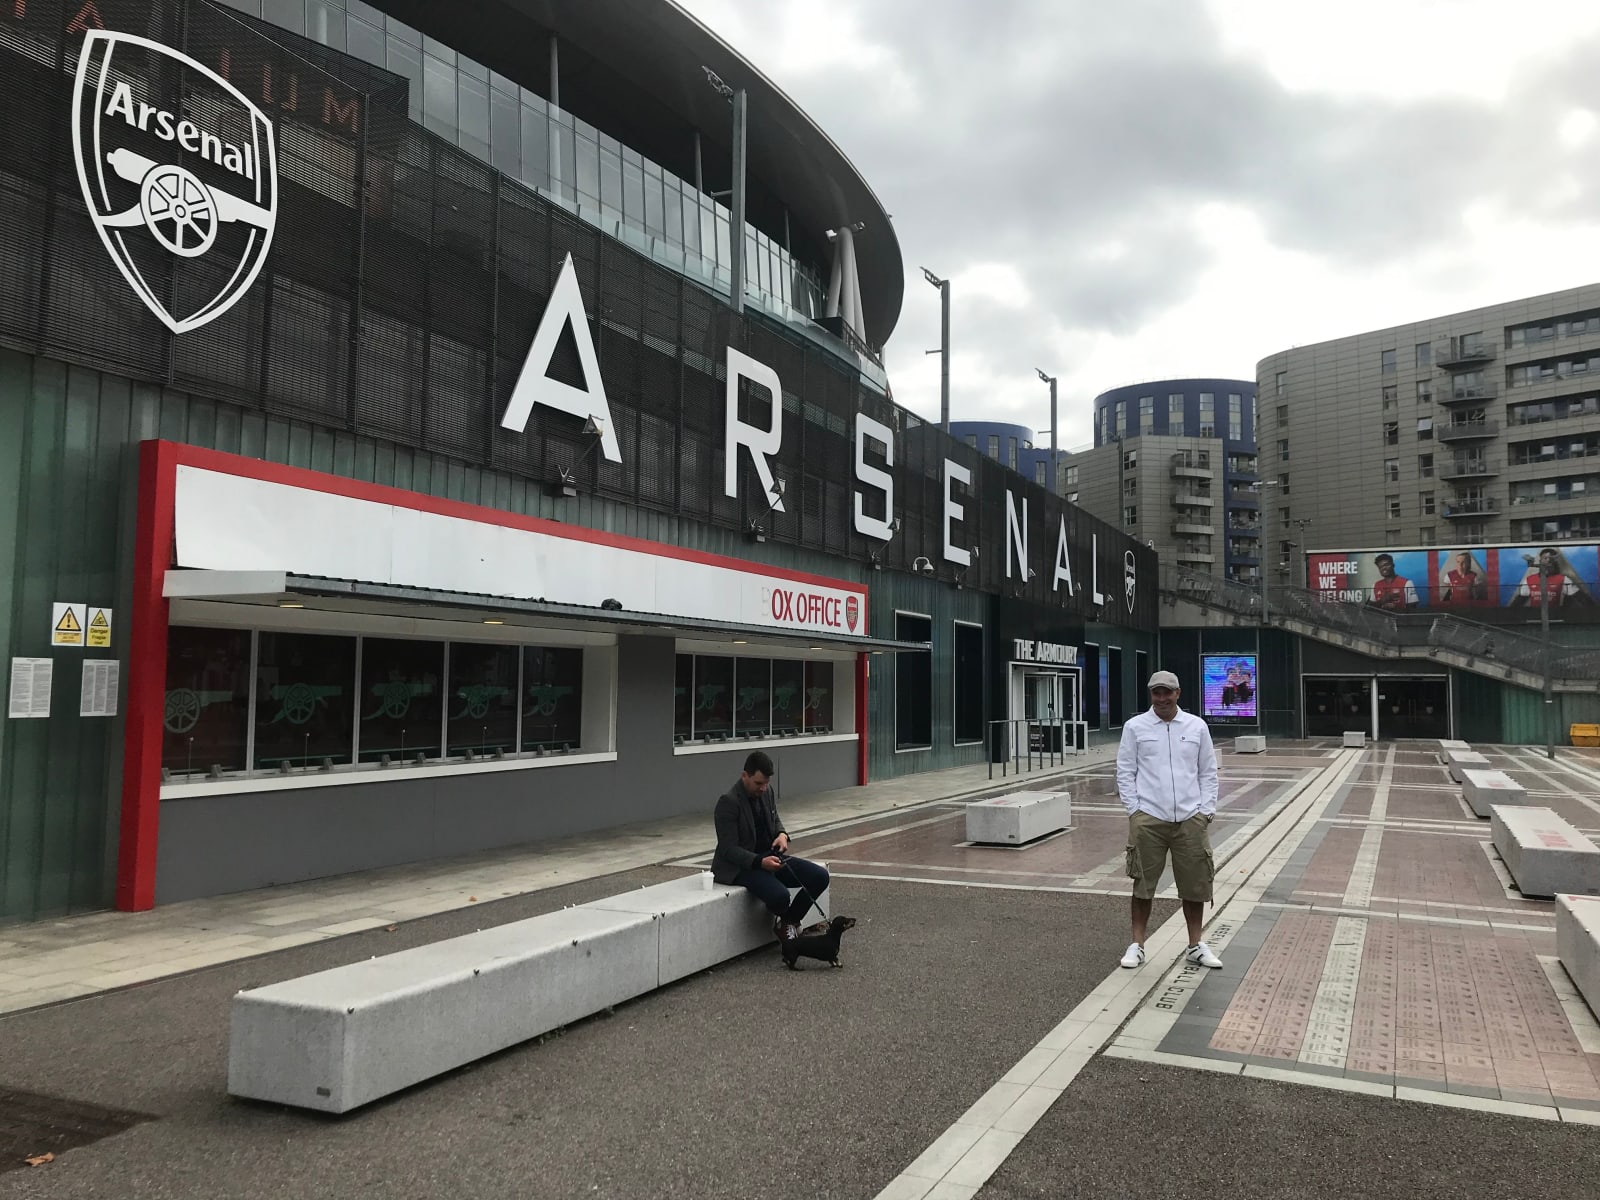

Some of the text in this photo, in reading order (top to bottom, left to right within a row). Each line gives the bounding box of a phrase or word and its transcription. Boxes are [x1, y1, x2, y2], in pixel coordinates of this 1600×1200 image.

[104, 81, 254, 180] Arsenal
[500, 251, 1105, 605] ARSENAL
[1319, 561, 1358, 575] WHERE
[1319, 576, 1337, 589] WE
[1320, 590, 1363, 603] BELONG
[796, 592, 842, 627] OFFICE
[1014, 638, 1078, 665] THE ARMOURY
[1156, 986, 1184, 1009] CLUB
